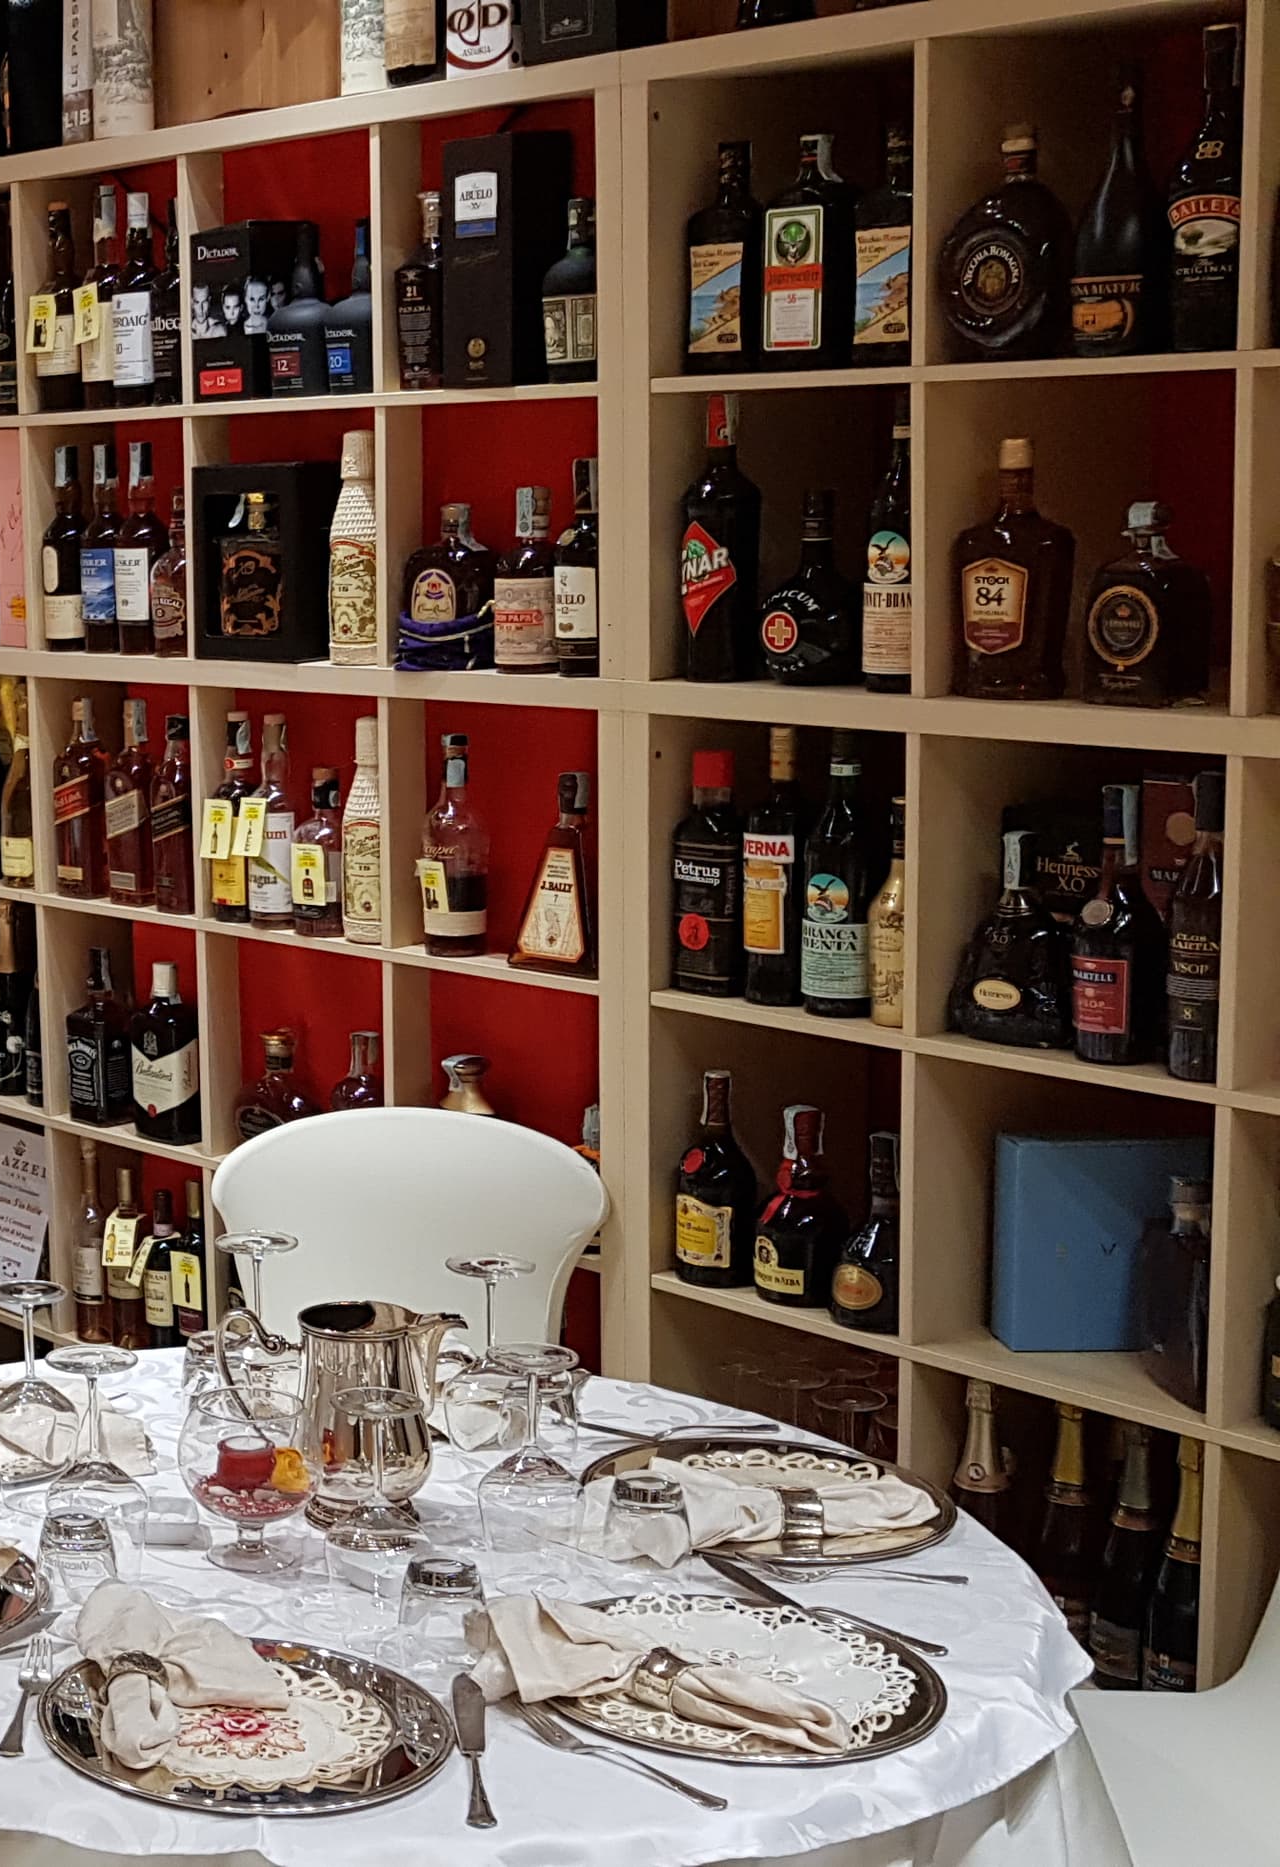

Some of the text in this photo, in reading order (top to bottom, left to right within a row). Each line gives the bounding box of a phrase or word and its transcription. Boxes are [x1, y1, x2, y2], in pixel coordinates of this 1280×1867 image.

[459, 188, 493, 202] ABUELO
[1172, 199, 1240, 222] BAILEYS
[963, 245, 1020, 287] VECCHIA ROMAGNA
[277, 360, 289, 371] 12
[974, 576, 1010, 586] STOCK
[975, 587, 1006, 607] 84
[744, 839, 790, 857] VERNA
[674, 858, 721, 878] Petrus
[1037, 857, 1101, 879] Henness
